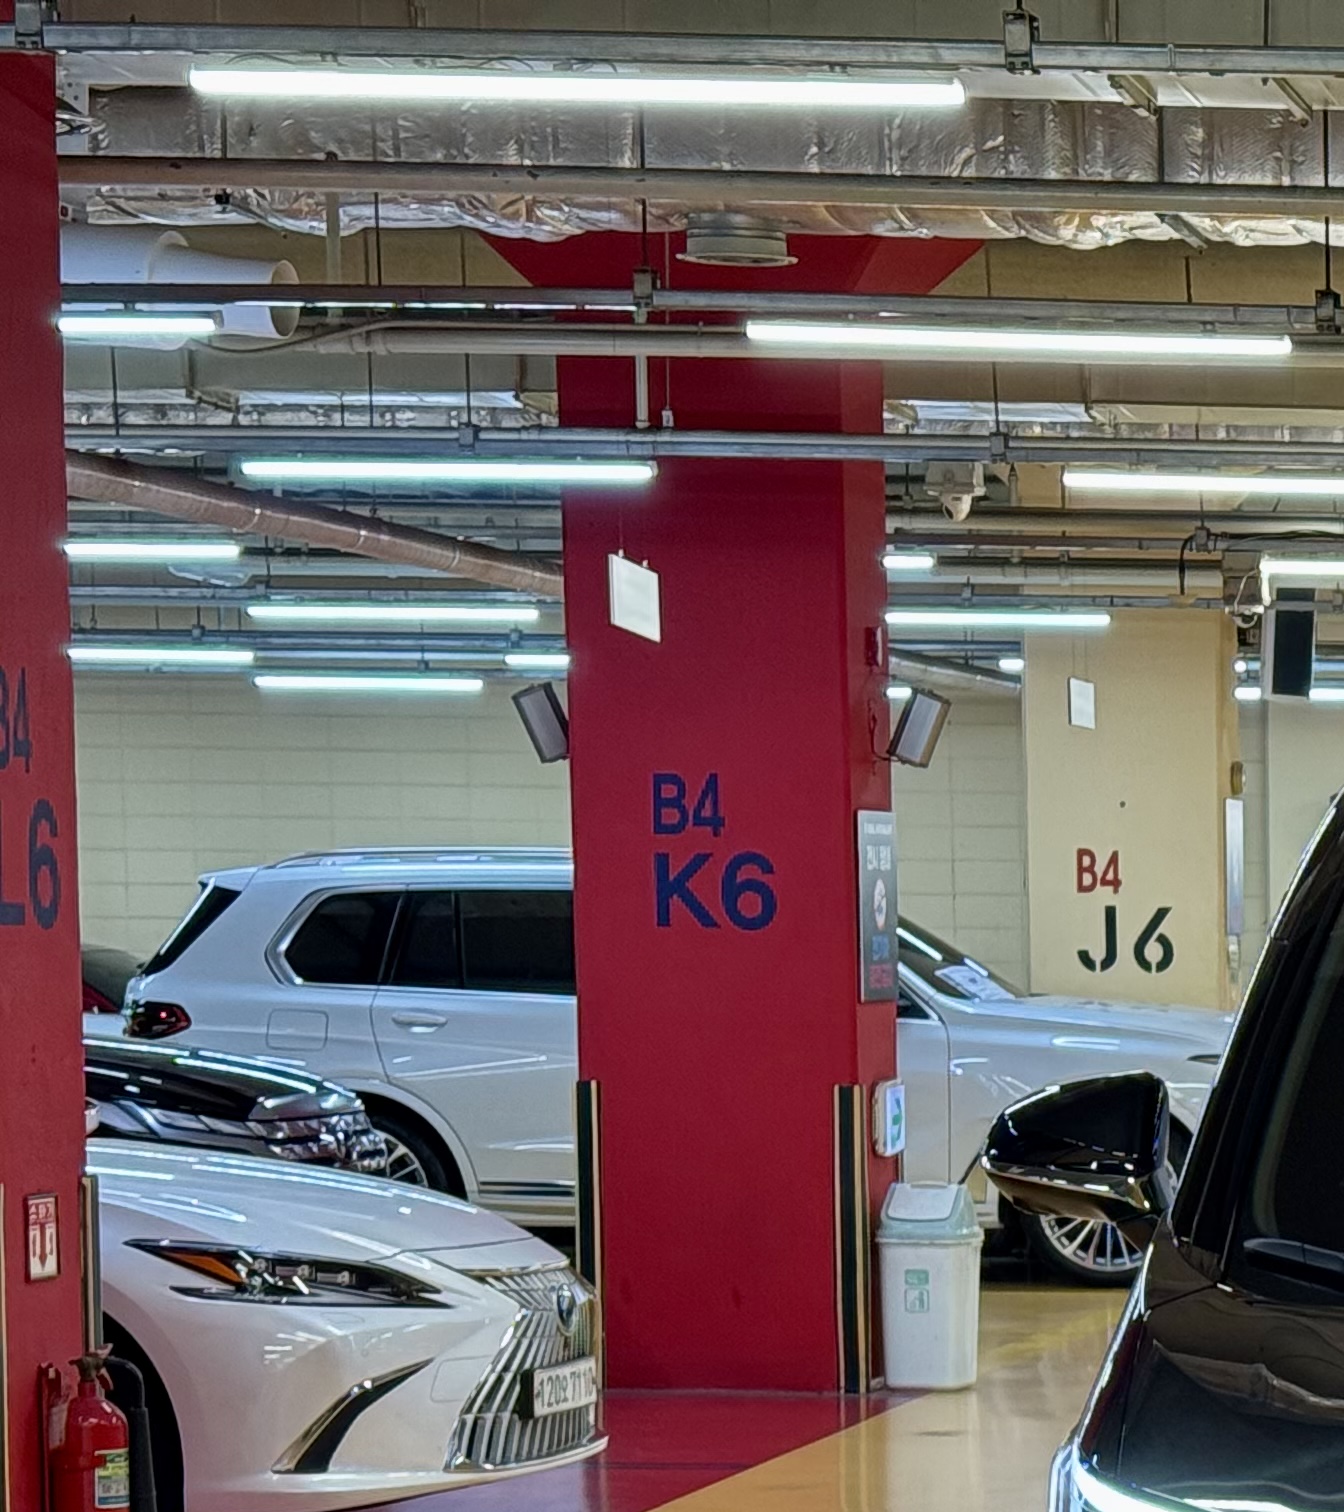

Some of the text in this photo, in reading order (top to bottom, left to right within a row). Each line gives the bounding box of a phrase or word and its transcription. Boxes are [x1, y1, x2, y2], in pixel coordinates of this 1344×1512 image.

[652, 772, 726, 837] B4
[654, 851, 778, 932] K6
[1076, 847, 1123, 895] B4
[1077, 905, 1175, 974] J6
